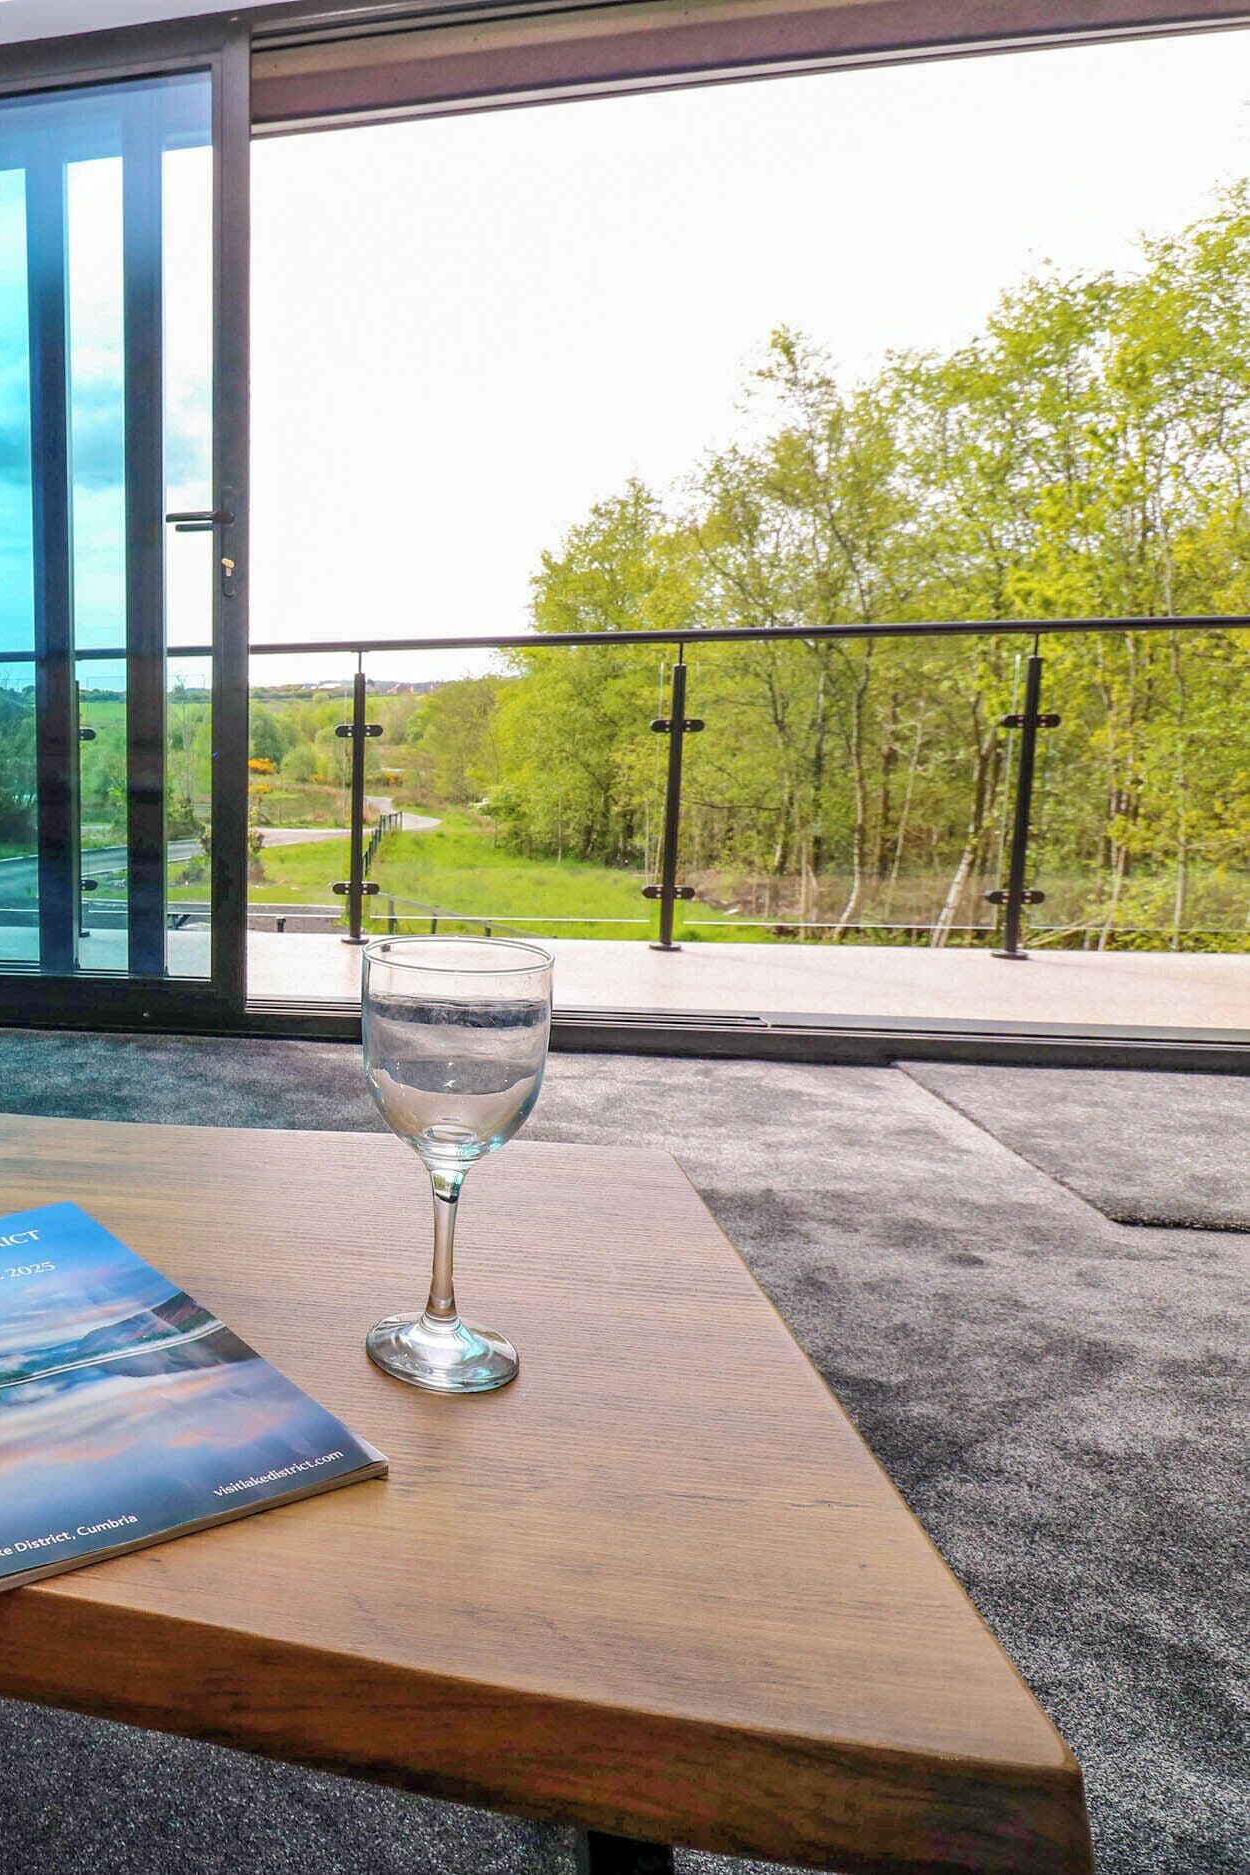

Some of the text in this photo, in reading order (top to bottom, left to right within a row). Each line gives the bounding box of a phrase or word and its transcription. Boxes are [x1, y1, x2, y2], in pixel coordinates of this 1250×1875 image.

[5, 1261, 55, 1278] 2025
[213, 1449, 344, 1497] visitlakedistrict.com
[14, 1530, 76, 1553] District,
[76, 1514, 138, 1536] Cumbria
